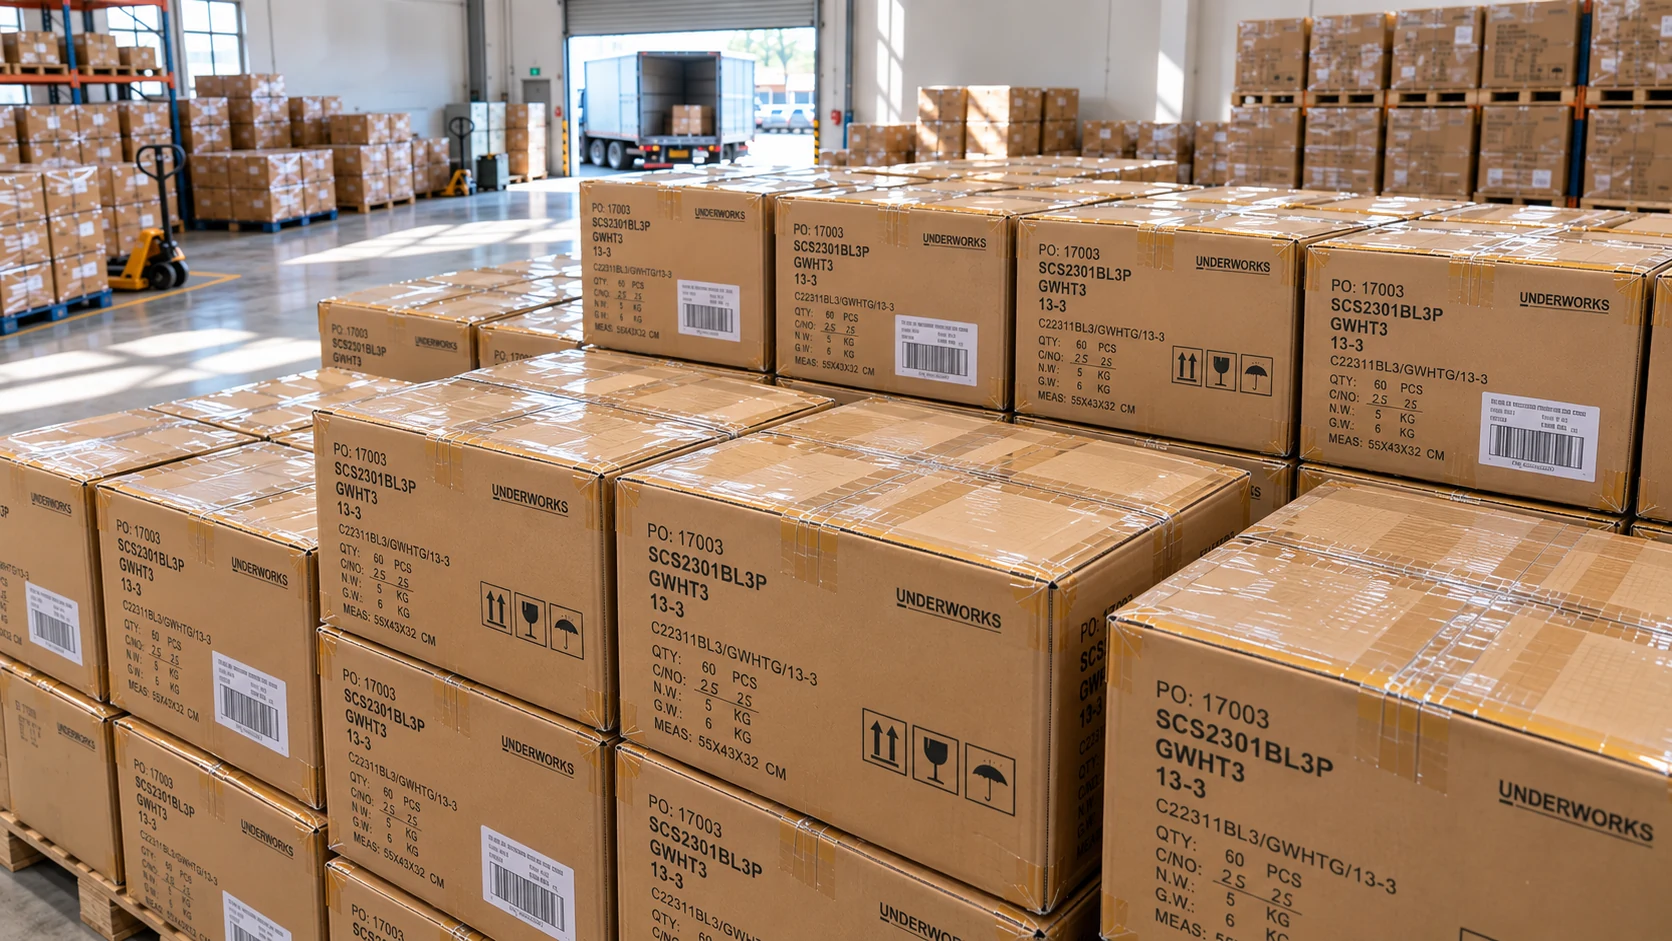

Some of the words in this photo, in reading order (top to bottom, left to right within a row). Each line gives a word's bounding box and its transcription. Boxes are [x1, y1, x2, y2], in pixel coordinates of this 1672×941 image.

[794, 223, 810, 235] PO:
[814, 225, 843, 238] 17003
[923, 233, 986, 248] UNDERWORKS
[794, 240, 869, 257] SCS2301BL3P
[1039, 243, 1059, 256] PO:
[1065, 246, 1100, 260] 17003
[794, 256, 833, 271] GWHT3
[1039, 261, 1131, 281] SCS2301BL3P
[1196, 256, 1270, 272] UNDERWORKS
[795, 273, 817, 286] 13-3
[1039, 280, 1086, 296] GWHT3
[1332, 279, 1356, 293] PO:
[1362, 282, 1404, 298] 17003
[1039, 297, 1066, 312] 13-3
[1331, 298, 1443, 322] SCS2301BL3P
[1520, 292, 1609, 311] UNDERWORKS
[1331, 317, 1387, 336] GWHT3
[1039, 335, 1060, 347] QTY:
[1076, 340, 1087, 350] 60
[1099, 342, 1116, 353] PCS
[1331, 336, 1363, 352] 13-3
[1077, 368, 1082, 377] 5
[1098, 371, 1110, 381] KG
[1330, 374, 1356, 387] QTY:
[1374, 379, 1387, 390] 60
[1401, 383, 1423, 395] PCS
[1077, 381, 1082, 390] 6
[1098, 384, 1110, 394] KG
[1038, 390, 1066, 403] MEAS:
[1120, 404, 1135, 414] CM
[1375, 409, 1381, 419] 5
[1400, 413, 1415, 424] KG
[1375, 424, 1381, 433] 6
[1400, 428, 1414, 438] KG
[334, 442, 351, 458] PO:
[355, 447, 386, 466] 17003
[1329, 433, 1362, 447] MEAS:
[1427, 449, 1444, 461] CM
[335, 461, 416, 494] SCS2301BL3P
[336, 481, 377, 504] GWHT3
[492, 484, 568, 513] UNDERWORKS
[338, 501, 361, 520] 13-3
[117, 519, 132, 535] PO:
[135, 525, 160, 545] 17003
[648, 523, 672, 543] PO:
[679, 530, 723, 555] 17003
[118, 538, 184, 572] SCS2301BL3P
[119, 557, 154, 581] GWHT3
[232, 557, 288, 586] UNDERWORKS
[649, 546, 767, 590] SCS2301BL3P
[121, 577, 141, 596] 13-3
[649, 570, 708, 601] GWHT3
[651, 593, 684, 618] 13-3
[897, 588, 1001, 628] UNDERWORKS
[652, 645, 681, 664] QTY:
[702, 661, 716, 675] 60
[733, 671, 757, 689] PCS
[653, 664, 686, 686] C/NO:
[343, 668, 360, 687] PO:
[365, 677, 396, 701] 17003
[344, 688, 425, 732] SCS2301BL3P
[705, 698, 712, 711] 5
[734, 708, 750, 725] KG
[1157, 680, 1192, 707] PO:
[1203, 693, 1269, 729] 17003
[346, 709, 387, 738] GWHT3
[706, 717, 712, 729] 6
[735, 727, 751, 744] KG
[347, 728, 371, 750] 13-3
[655, 717, 691, 742] MEAS:
[766, 762, 786, 781] CM
[1156, 709, 1333, 776] SCS2301BL3P
[502, 735, 574, 775] UNDERWORKS
[1156, 739, 1244, 782] GWHT3
[1157, 767, 1205, 798] 13-3
[649, 794, 673, 817] PO:
[679, 807, 722, 838] 17003
[1499, 780, 1653, 842] UNDERWORKS
[650, 816, 762, 878] SCS2301BL3P
[650, 839, 707, 878] GWHT3
[1156, 825, 1196, 851] QTY:
[1226, 849, 1244, 867] 60
[1267, 863, 1301, 888] PCS
[1156, 847, 1201, 875] C/NO:
[651, 862, 683, 889] 13-3
[352, 904, 369, 924] PO:
[652, 909, 679, 932] QTY:
[1226, 892, 1235, 906] 5
[1267, 906, 1289, 928] KG
[1226, 913, 1235, 927] 6
[1156, 908, 1206, 940] MEAS:
